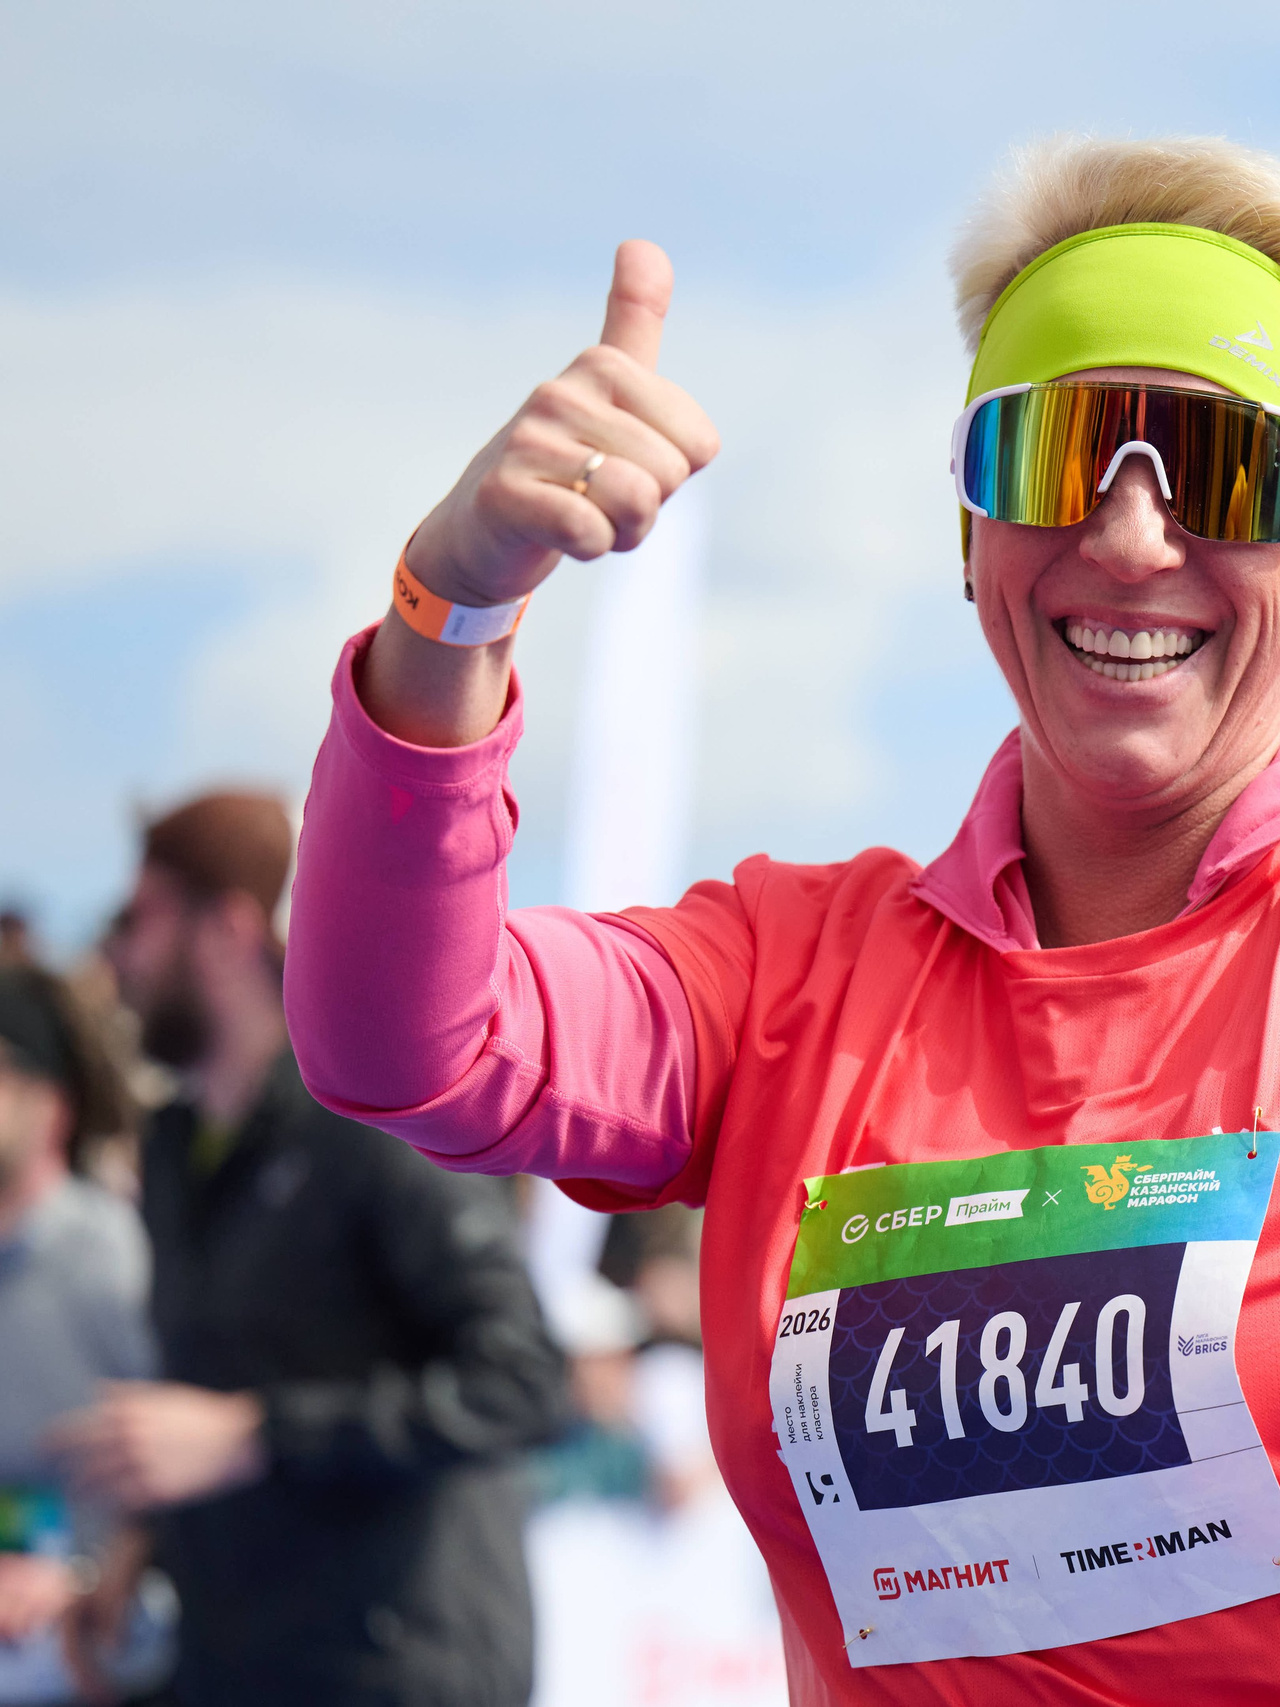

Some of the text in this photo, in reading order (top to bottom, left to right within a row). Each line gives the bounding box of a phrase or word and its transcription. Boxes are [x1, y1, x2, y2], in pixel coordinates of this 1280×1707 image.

[1129, 1179, 1221, 1197] КАЗАНСКИЙ
[1133, 1168, 1216, 1185] СБЕРПРАЙМ
[875, 1205, 943, 1233] СБЕР
[955, 1198, 1011, 1218] Прайм
[1126, 1193, 1199, 1208] МАРАФОН
[779, 1307, 831, 1338] 2026
[1195, 1341, 1227, 1355] BRICS
[864, 1294, 1147, 1448] 41840
[794, 1363, 812, 1442] для наклейки
[809, 1385, 824, 1440] кластера
[784, 1406, 798, 1444] Место
[903, 1559, 1010, 1593] МАГНИТ
